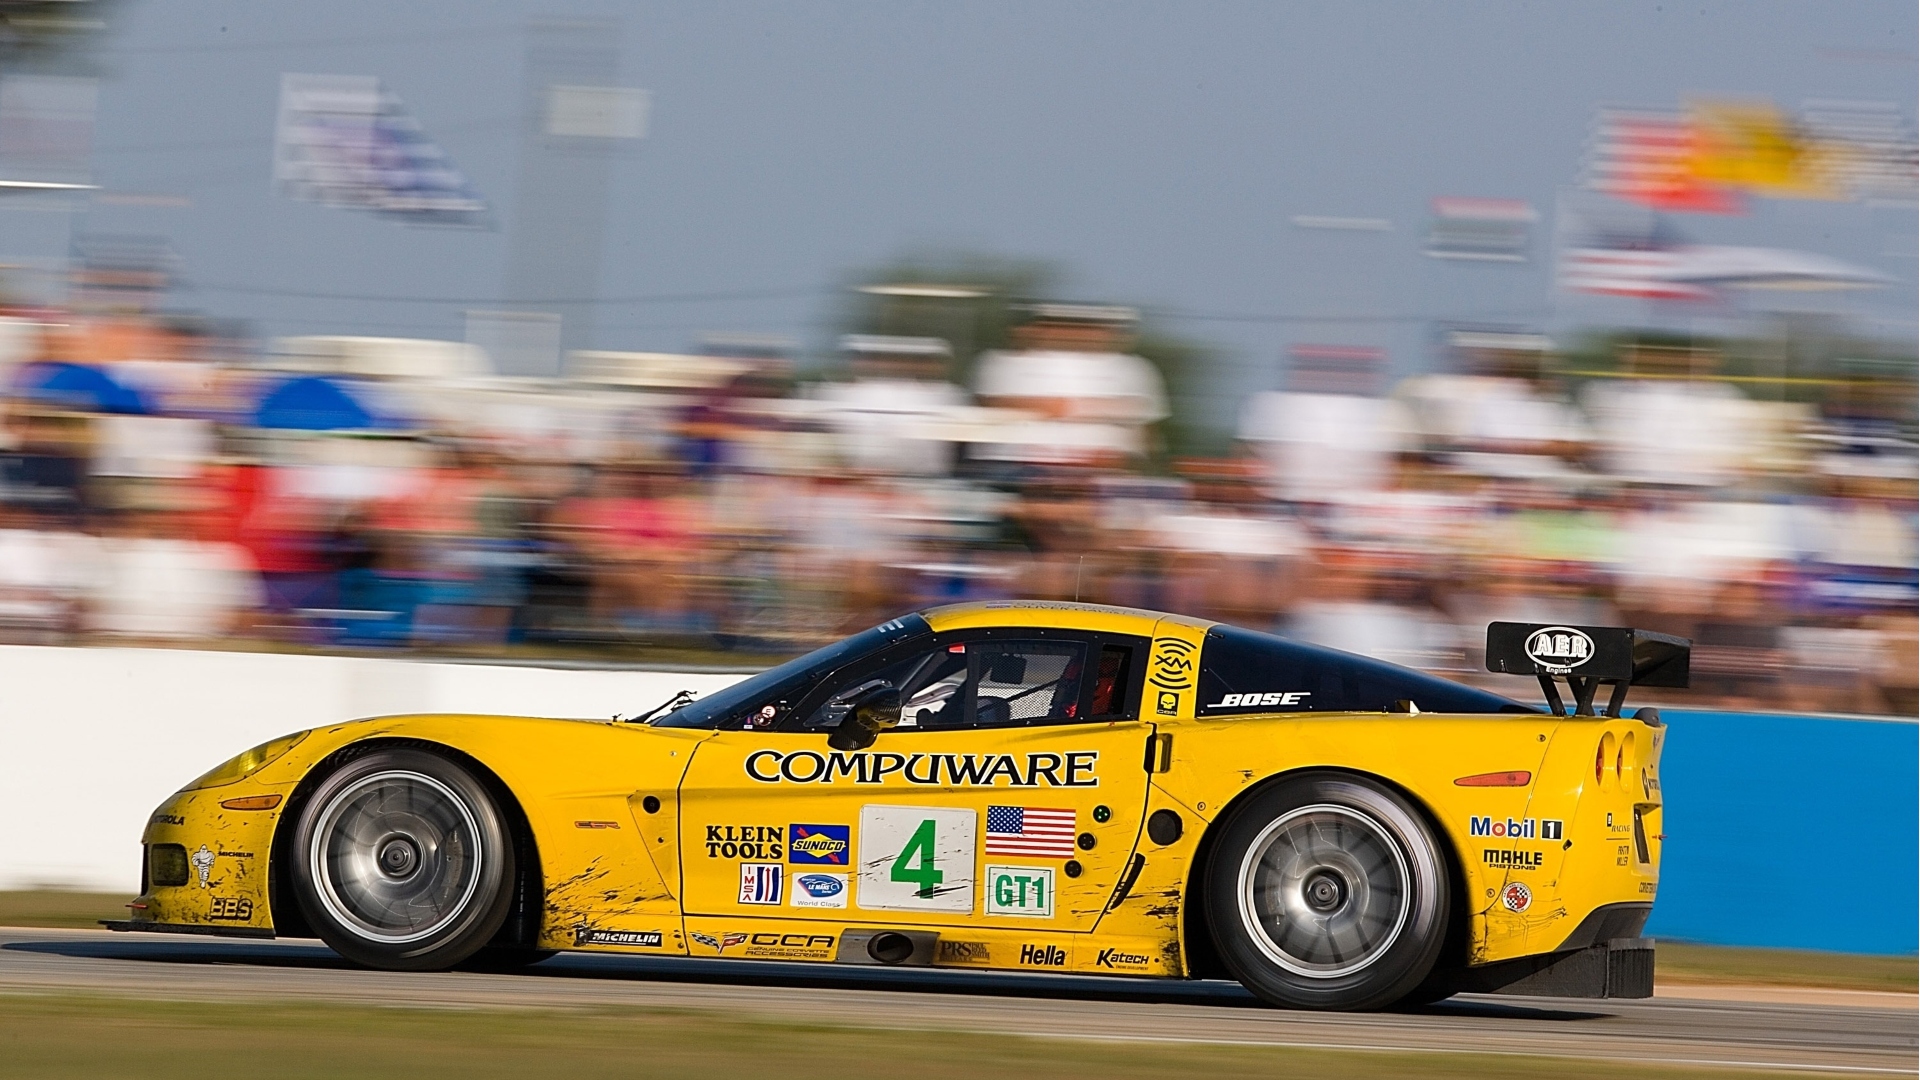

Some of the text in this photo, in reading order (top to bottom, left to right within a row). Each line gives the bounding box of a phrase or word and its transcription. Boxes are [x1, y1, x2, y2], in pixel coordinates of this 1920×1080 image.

[1532, 633, 1588, 658] AER
[1154, 654, 1192, 671] XM
[1546, 666, 1572, 674] Engines
[1207, 692, 1312, 708] BOSE
[745, 750, 1099, 787] COMPUWARE
[706, 825, 784, 842] KLEIN
[1471, 816, 1535, 838] Mobil
[706, 842, 783, 860] TOOLS
[794, 840, 843, 851] SUNOCO
[891, 819, 943, 900] 4
[1483, 849, 1543, 865] MAHLE
[995, 874, 1045, 908] GT1
[210, 897, 253, 921] BBS
[592, 932, 660, 943] MICHELIN
[751, 933, 835, 948] GCA
[941, 941, 972, 956] PRS
[1020, 944, 1065, 966] Hella
